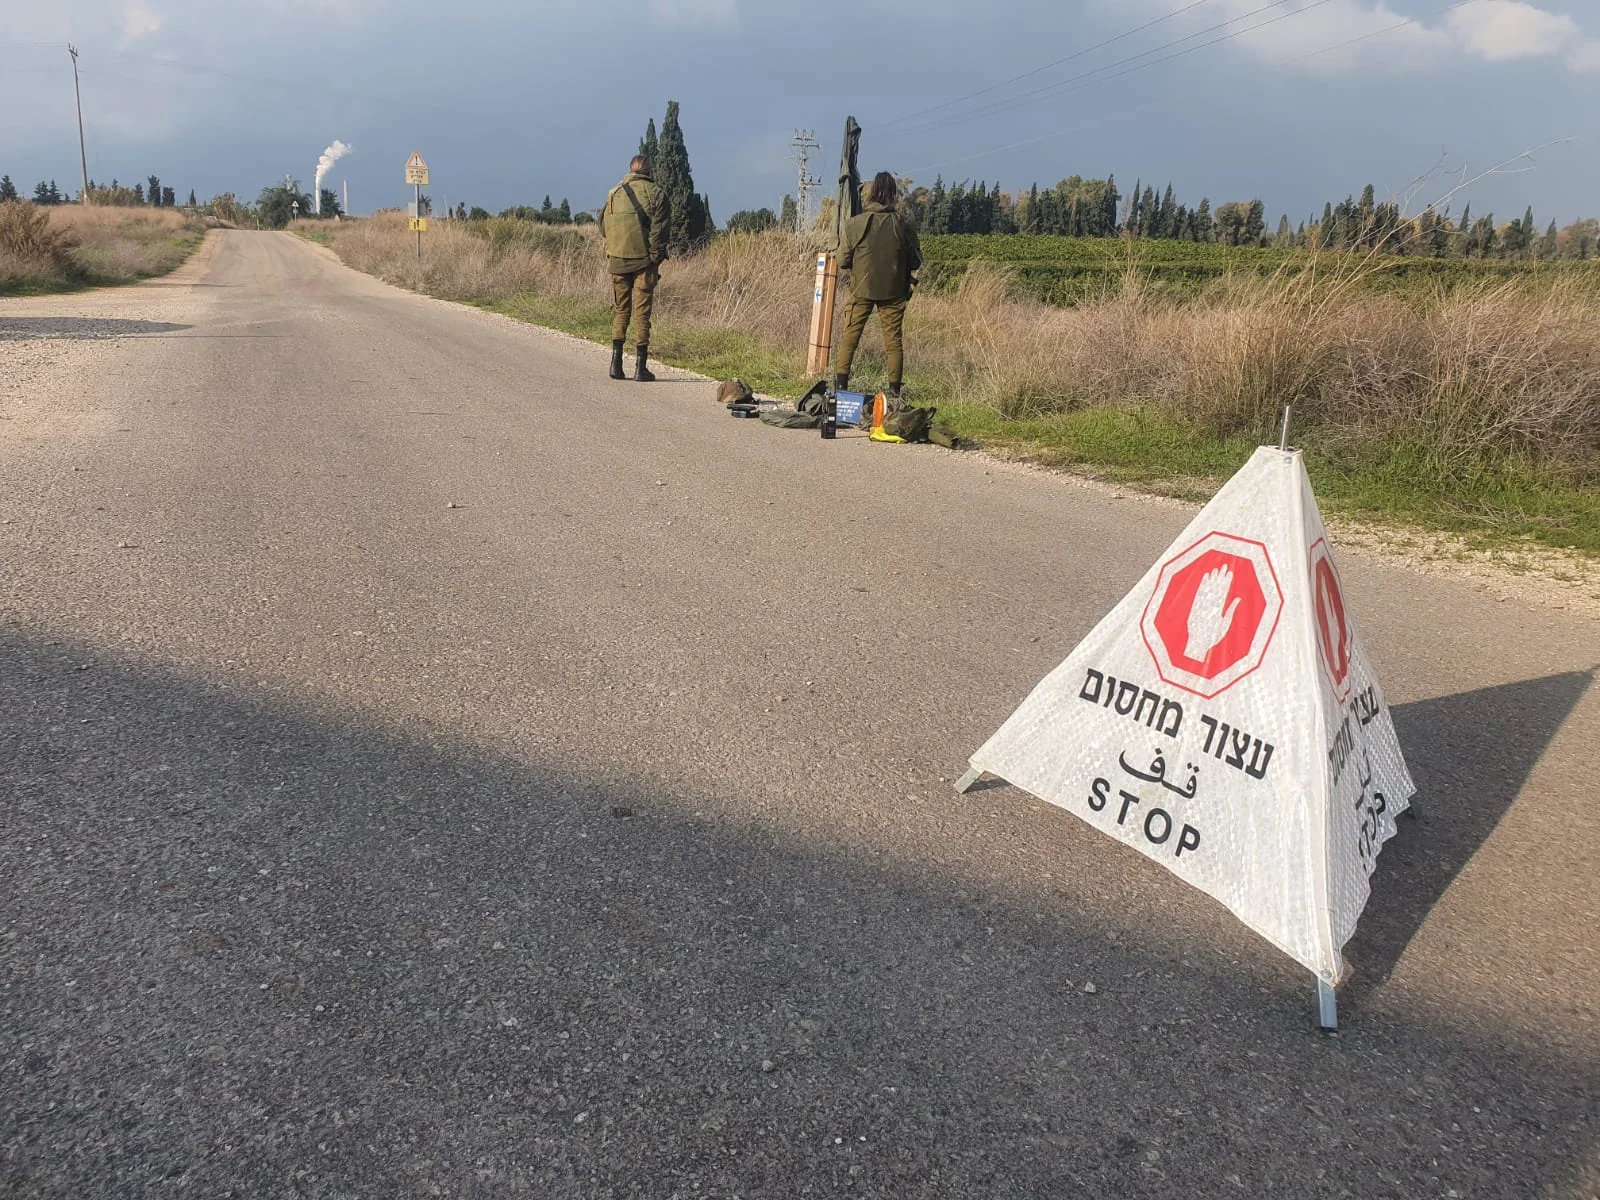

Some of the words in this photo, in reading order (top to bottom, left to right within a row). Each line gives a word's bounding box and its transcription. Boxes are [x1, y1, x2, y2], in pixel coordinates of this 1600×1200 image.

[1079, 668, 1183, 738] מחסום
[1119, 746, 1200, 799] قف
[1201, 714, 1274, 780] עצור
[1088, 778, 1200, 857] STOP
